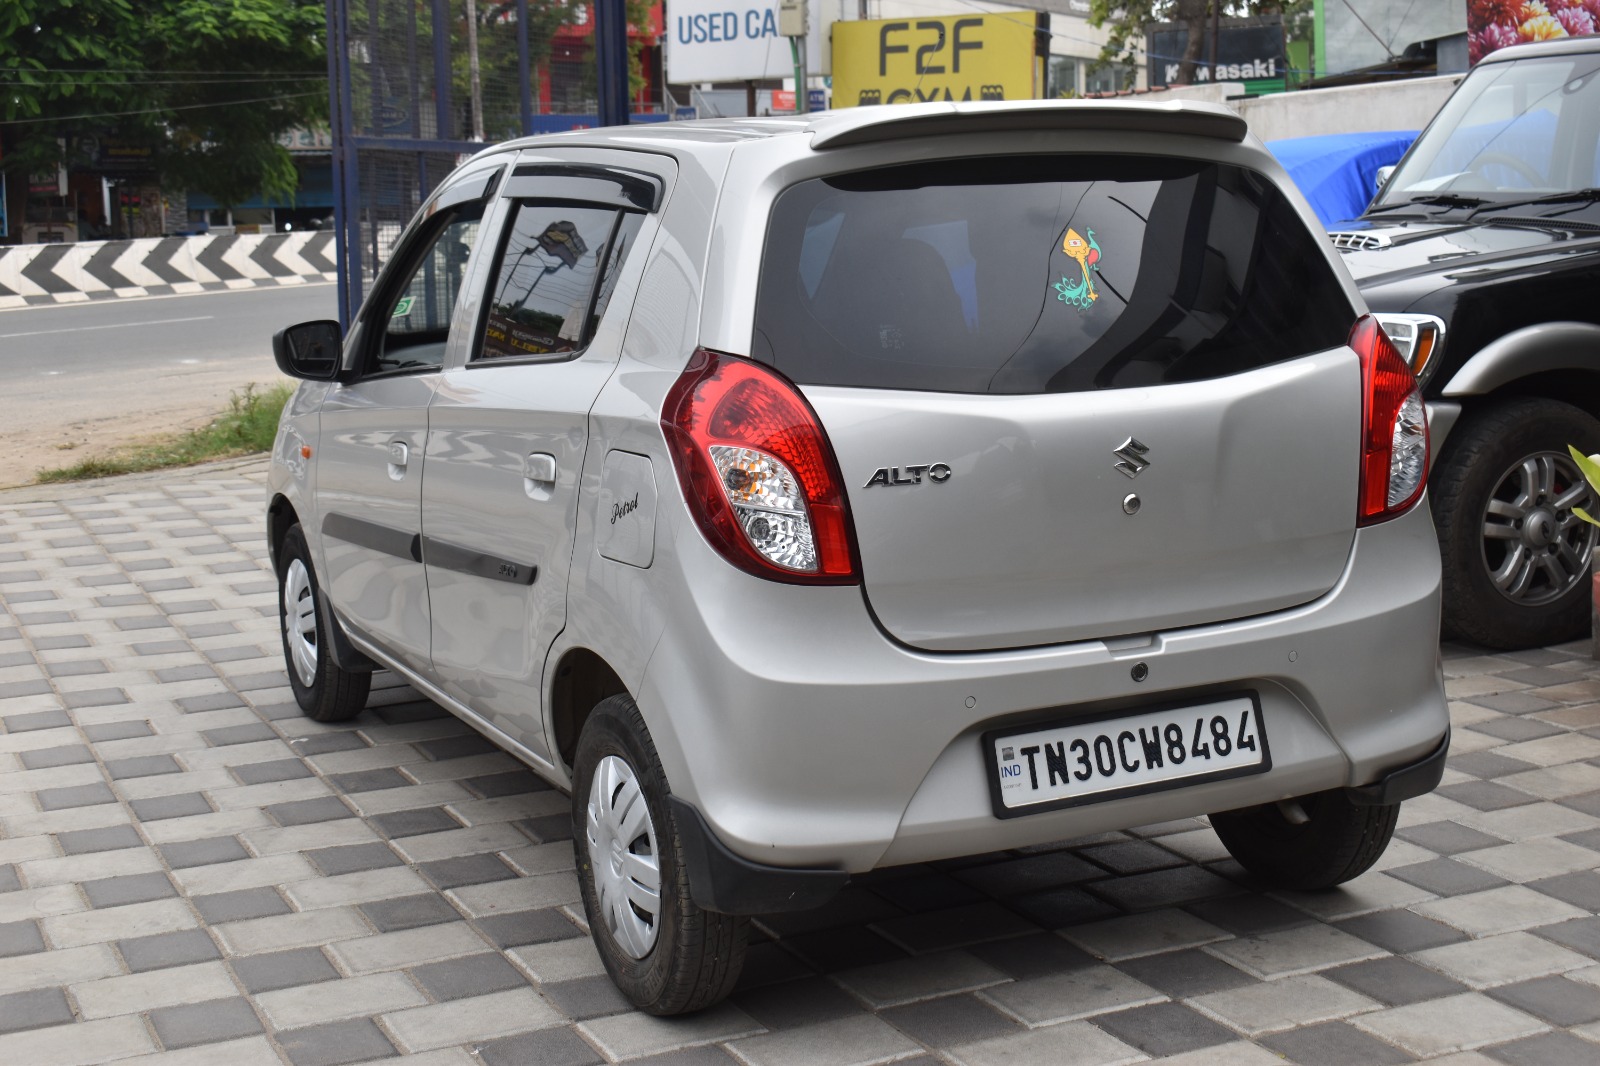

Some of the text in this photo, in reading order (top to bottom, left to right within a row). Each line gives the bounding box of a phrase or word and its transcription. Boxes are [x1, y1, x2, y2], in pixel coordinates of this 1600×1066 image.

[678, 8, 778, 45] USED CA
[879, 18, 984, 77] F2F
[1165, 58, 1276, 83] Kwasaki
[862, 462, 951, 488] ALTO
[1020, 710, 1256, 790] TN30CW8484
[1000, 764, 1021, 778] IND
